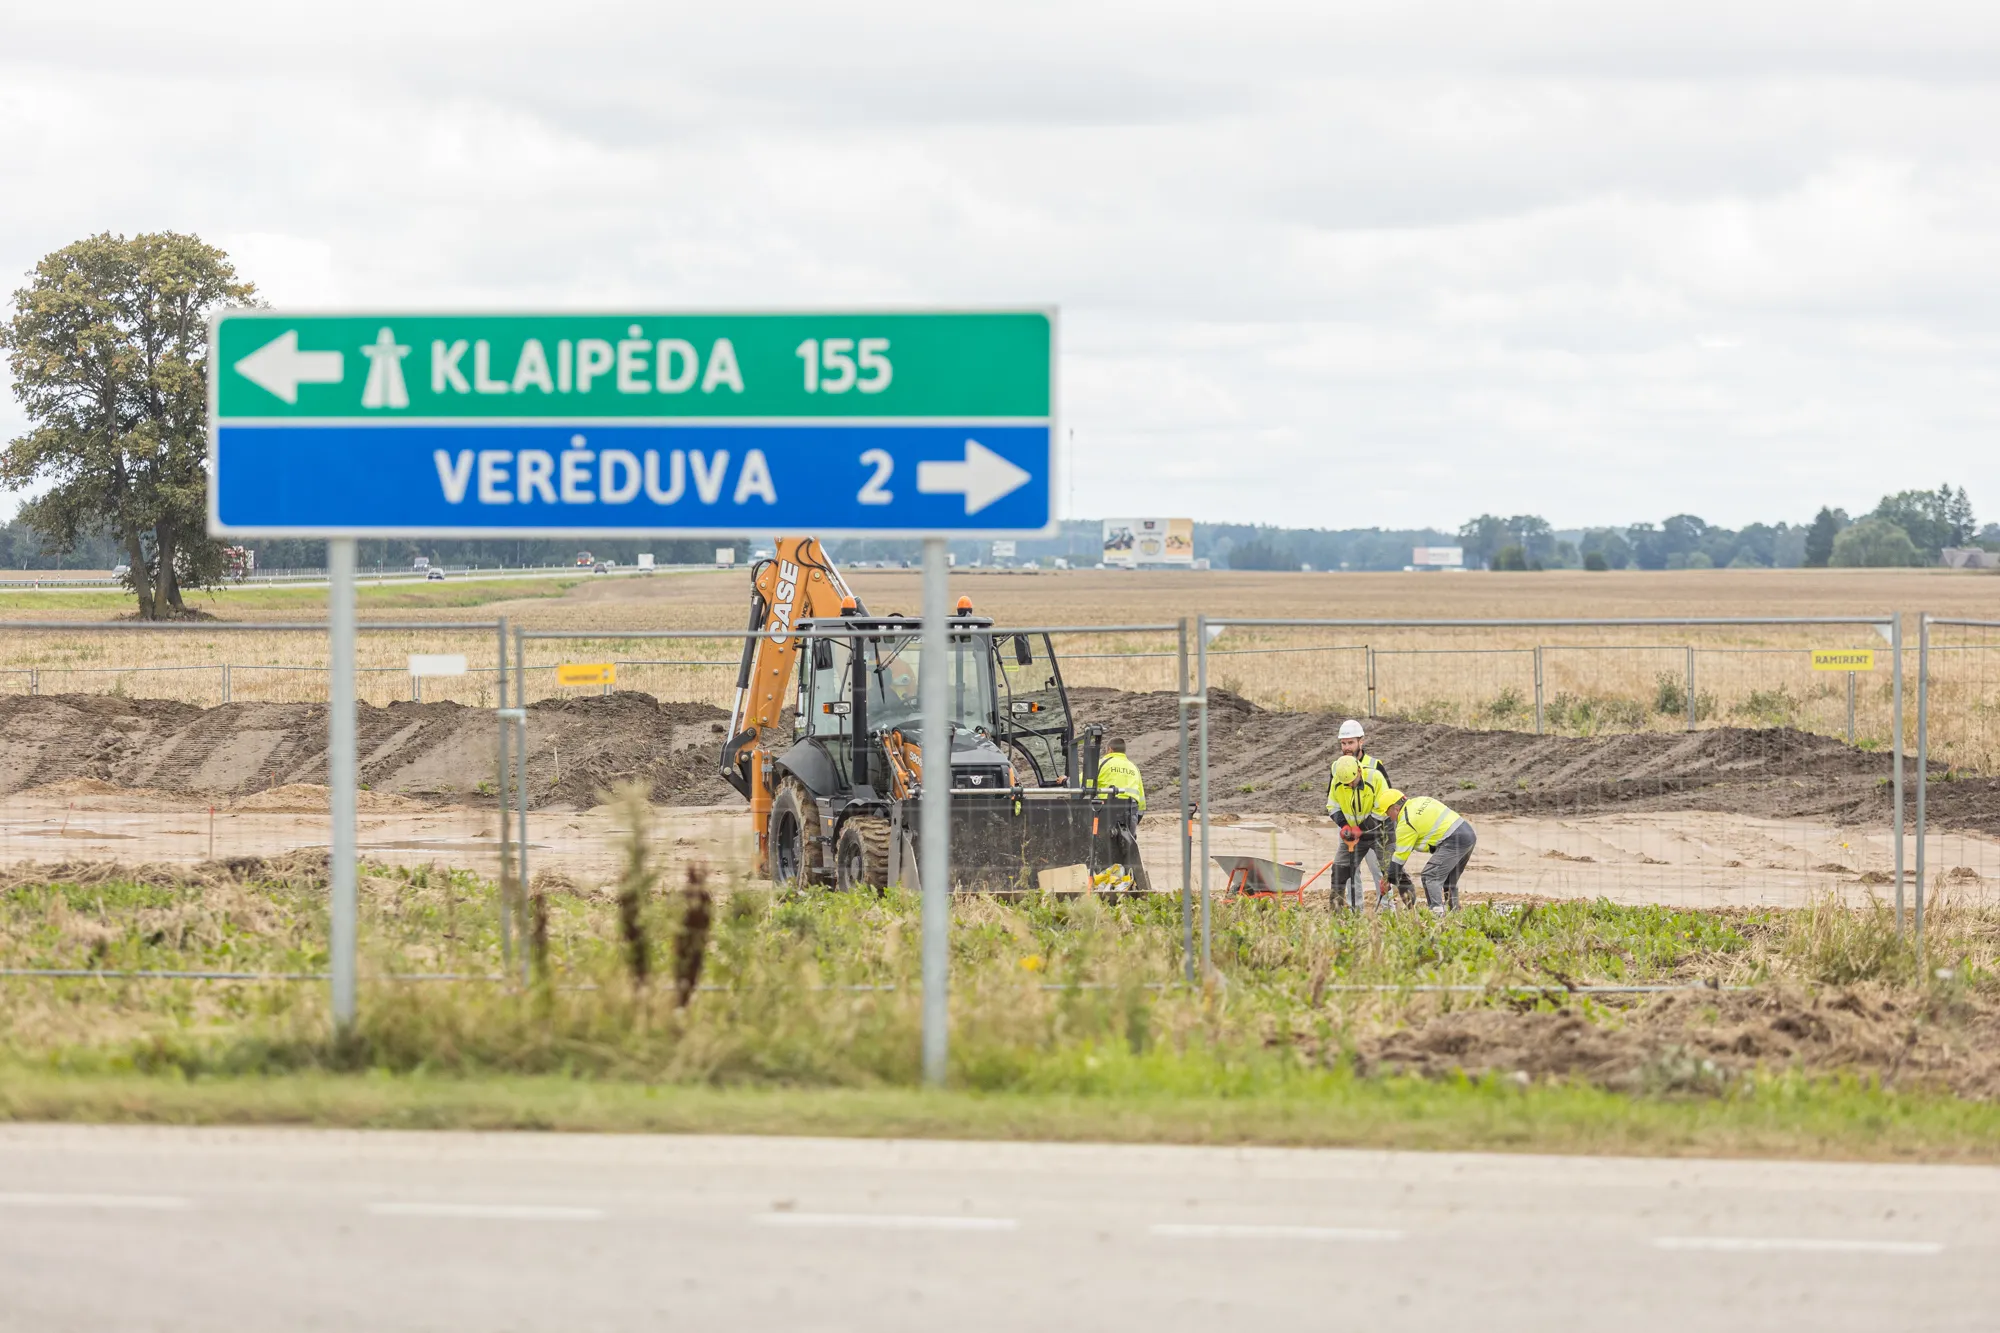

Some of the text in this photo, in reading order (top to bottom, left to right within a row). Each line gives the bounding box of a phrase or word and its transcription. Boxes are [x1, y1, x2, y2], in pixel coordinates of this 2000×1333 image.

[431, 324, 894, 394] KLAIPĖDA 155
[433, 434, 895, 505] VERĖDUVA 2
[769, 559, 799, 644] CASE
[1815, 655, 1869, 664] RAMIRENT
[909, 751, 923, 767] 580S
